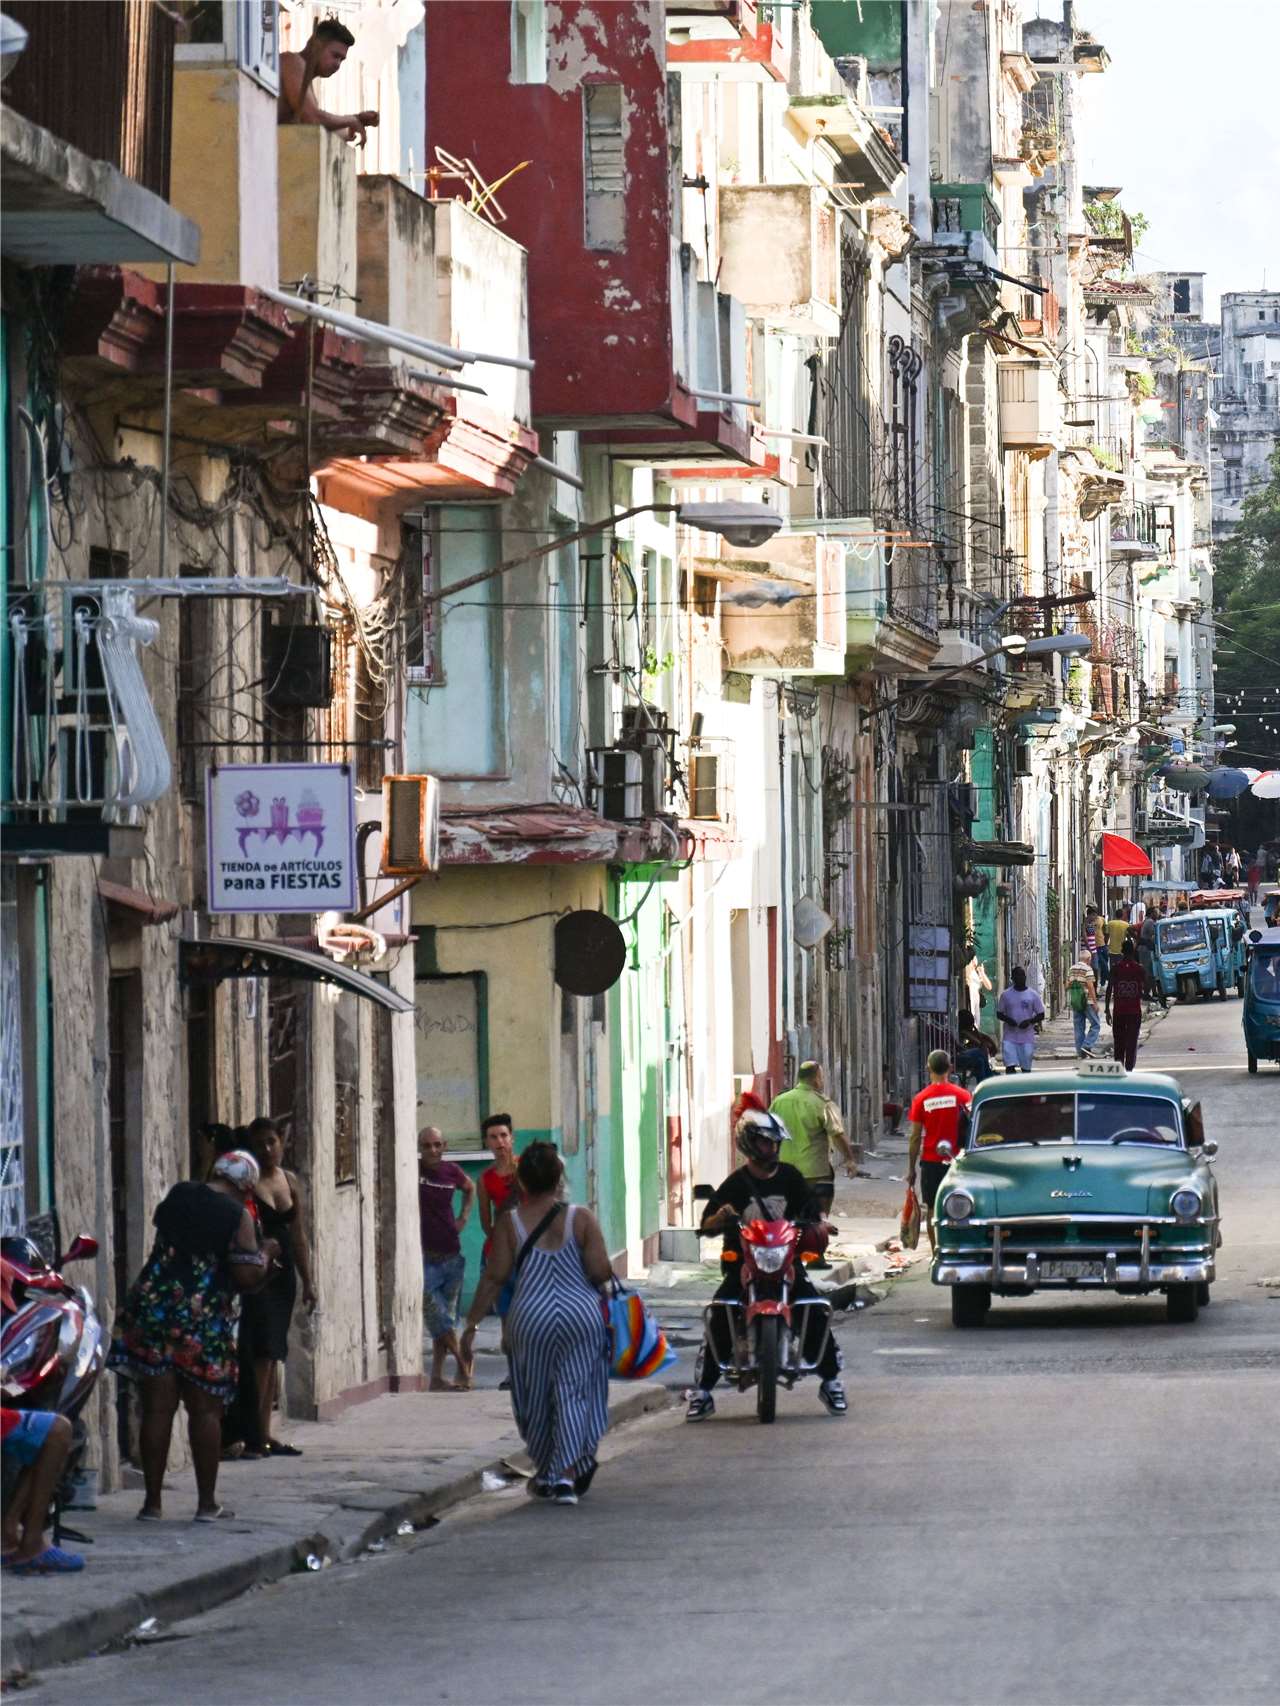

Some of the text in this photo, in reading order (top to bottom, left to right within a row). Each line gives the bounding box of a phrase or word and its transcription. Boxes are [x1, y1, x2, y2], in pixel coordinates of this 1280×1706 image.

[220, 862, 260, 872] TIENDA
[279, 859, 343, 872] ARTÍCULOS
[270, 872, 342, 890] FIESTAS
[1087, 1064, 1120, 1073] TAXI
